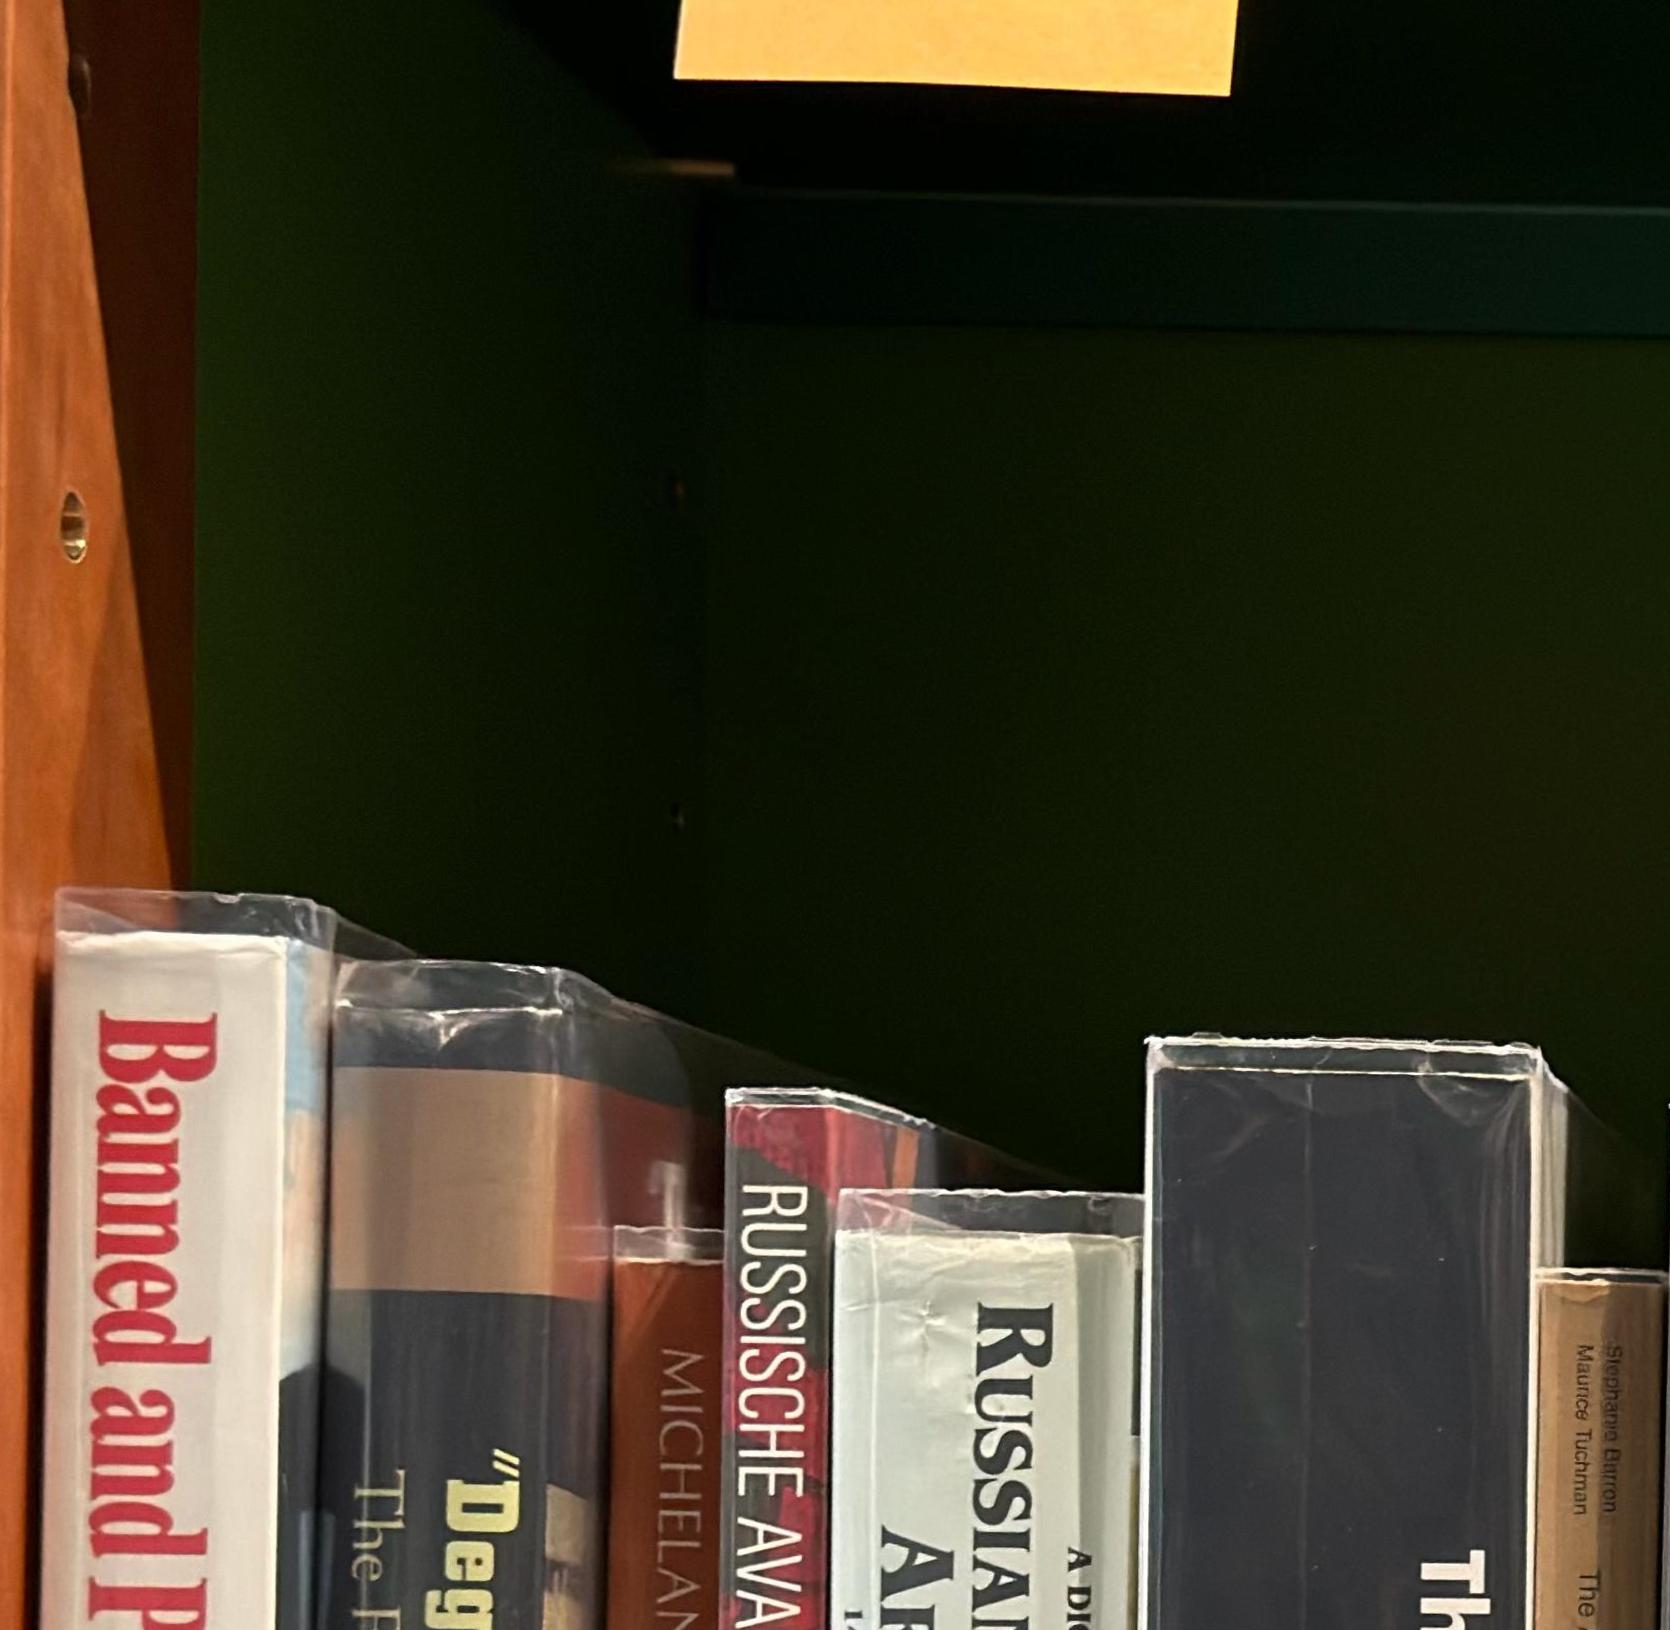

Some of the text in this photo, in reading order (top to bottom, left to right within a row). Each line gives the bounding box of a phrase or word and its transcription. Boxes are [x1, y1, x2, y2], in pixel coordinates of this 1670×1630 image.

[96, 1012, 218, 1365] Banned
[738, 1184, 808, 1497] RUSSISCHE
[89, 1387, 208, 1555] and
[353, 1470, 408, 1583] The
[1066, 1547, 1091, 1566] A
[1578, 1571, 1601, 1618] The
